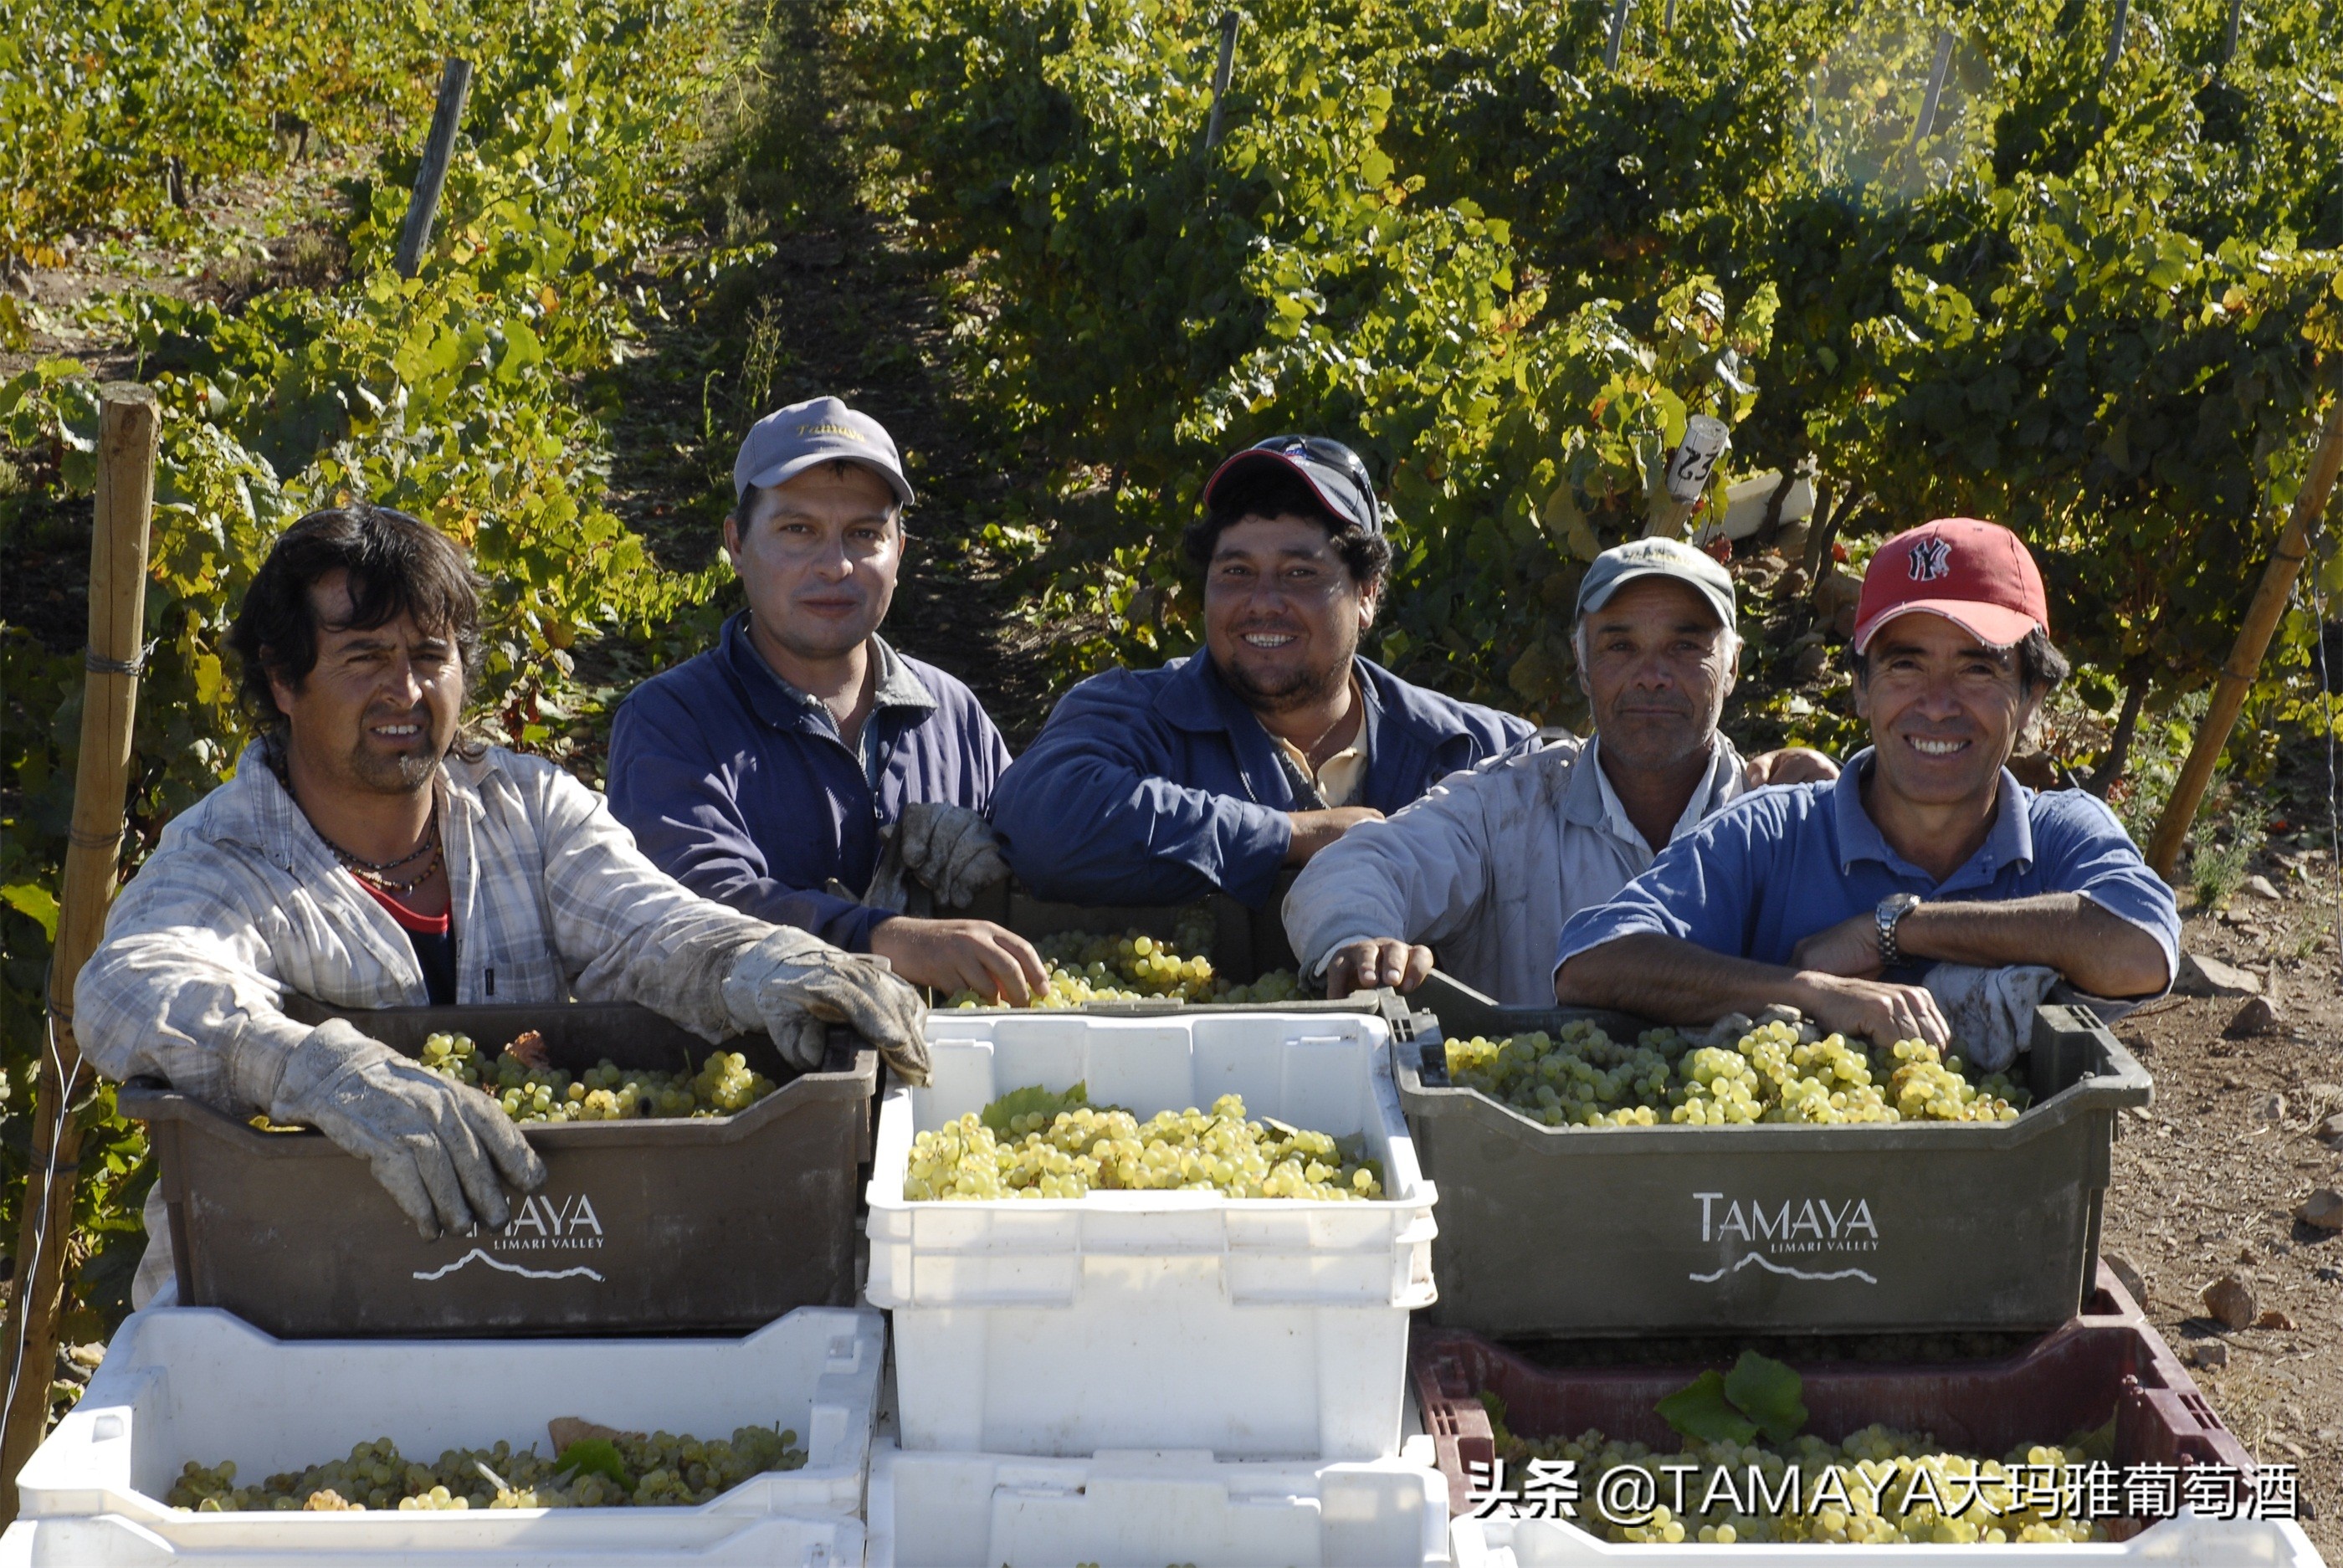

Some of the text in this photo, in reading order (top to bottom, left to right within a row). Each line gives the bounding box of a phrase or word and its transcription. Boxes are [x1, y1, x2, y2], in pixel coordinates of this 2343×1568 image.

[440, 1193, 603, 1238] AYA
[1692, 1192, 1879, 1243] TAMAYA
[494, 1237, 604, 1250] LIMARI VALLEY
[1770, 1240, 1879, 1253] LIMARI VALLEY
